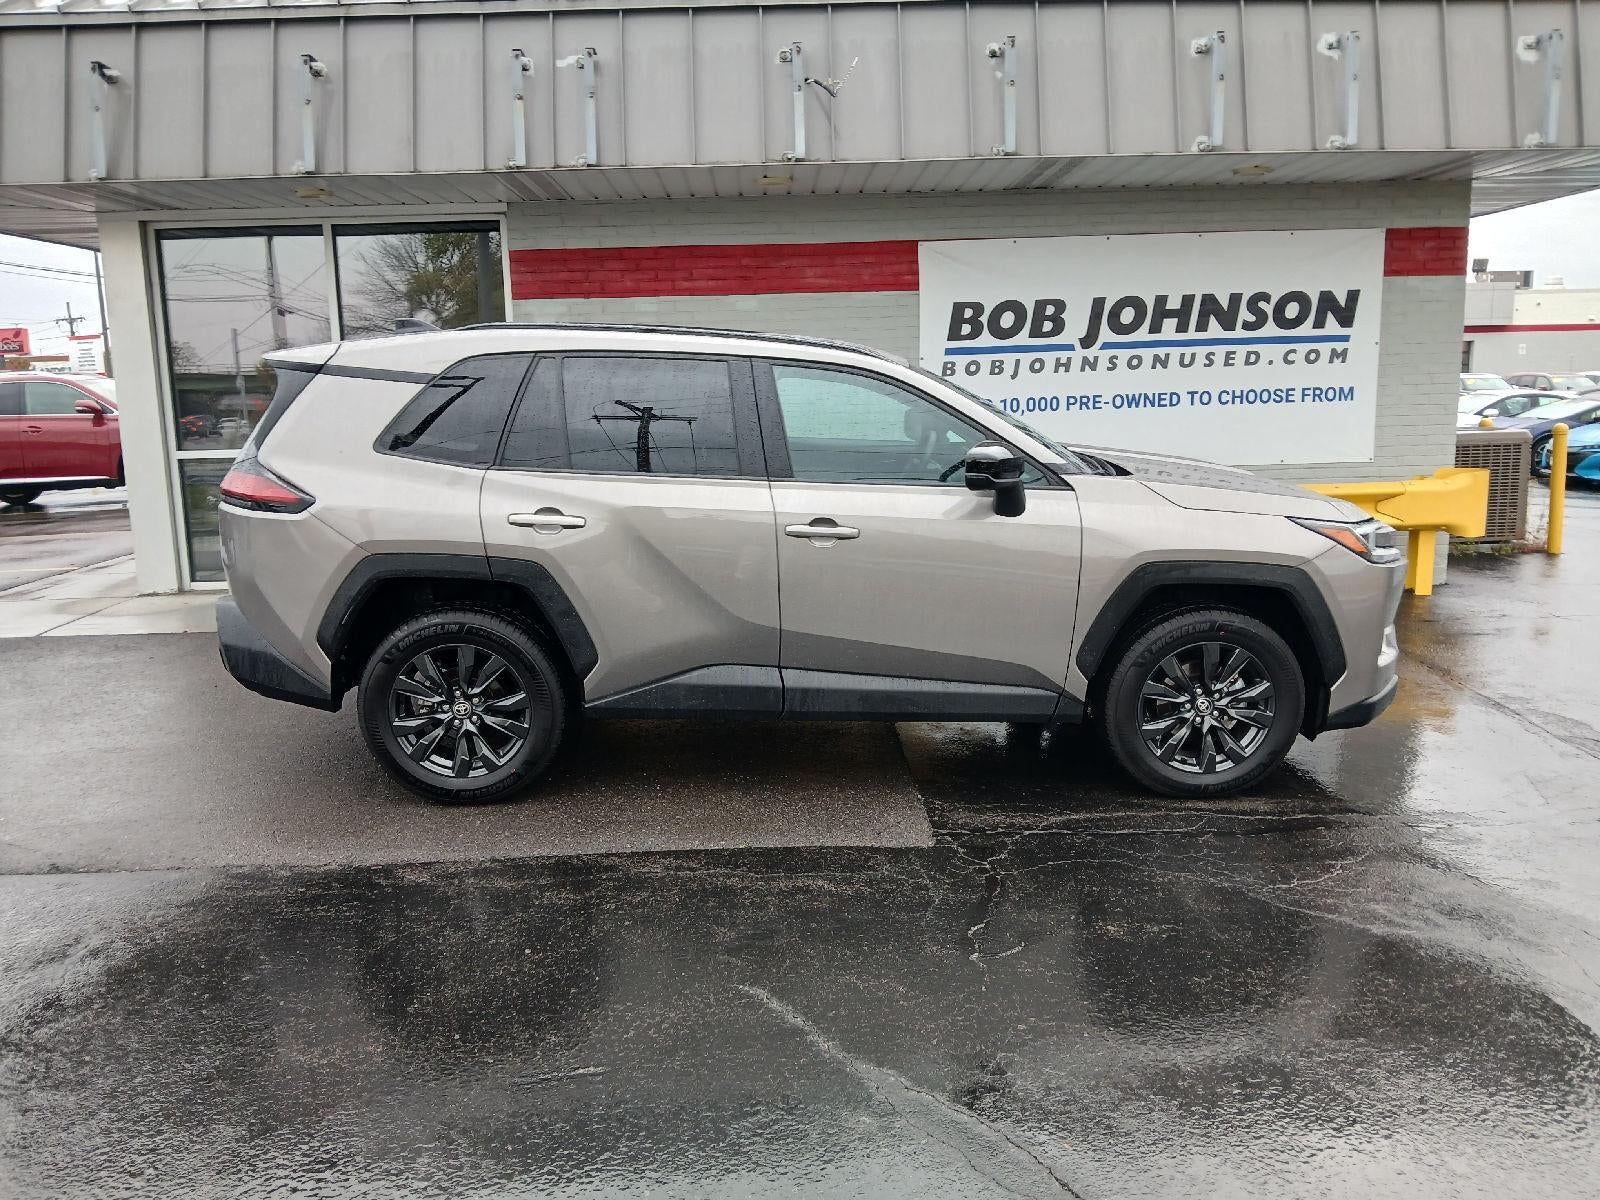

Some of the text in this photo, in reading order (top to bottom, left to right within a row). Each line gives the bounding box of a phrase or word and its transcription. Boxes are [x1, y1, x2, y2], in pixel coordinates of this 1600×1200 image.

[947, 289, 1361, 350] BOB JOHNSON
[942, 347, 1350, 380] BOBJOHNSONUSED.COM
[1000, 396, 1060, 416] 10,000
[1066, 393, 1181, 411] PRE-OWNED
[1187, 390, 1212, 406] TO
[1217, 388, 1296, 405] CHOOSE
[1301, 386, 1355, 403] FROM
[399, 625, 460, 649] MICHELIN
[1153, 622, 1211, 651] MICHELIN
